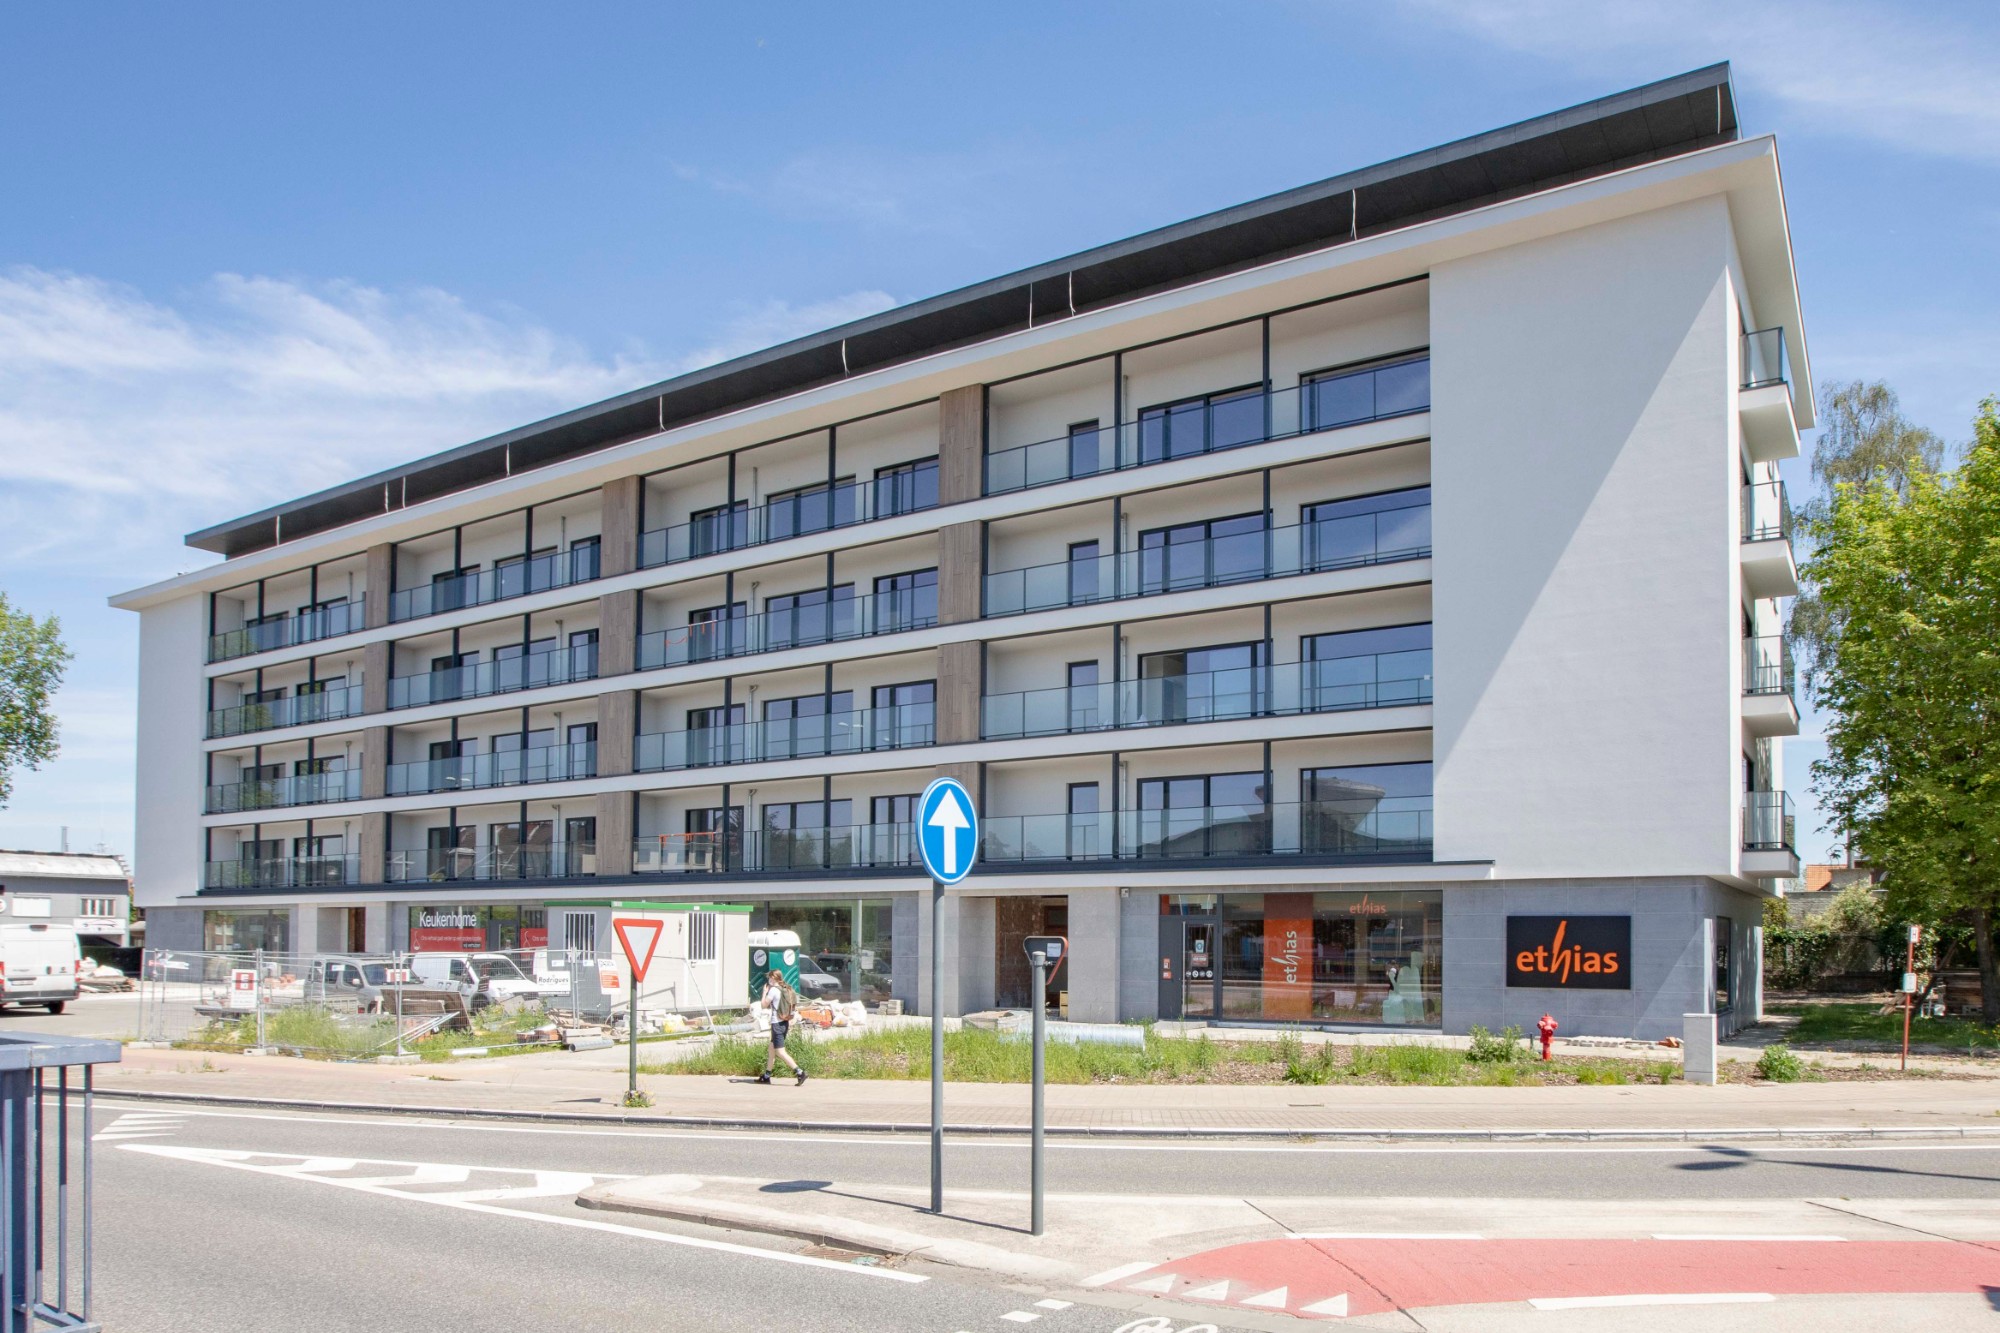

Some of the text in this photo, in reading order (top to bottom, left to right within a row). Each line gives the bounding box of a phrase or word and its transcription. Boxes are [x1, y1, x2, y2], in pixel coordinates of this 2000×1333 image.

[1349, 893, 1386, 917] ethias
[419, 911, 477, 927] Keukenhome
[1271, 930, 1302, 984] ethias
[1516, 920, 1619, 984] ethias
[538, 976, 569, 984] Rodrigues
